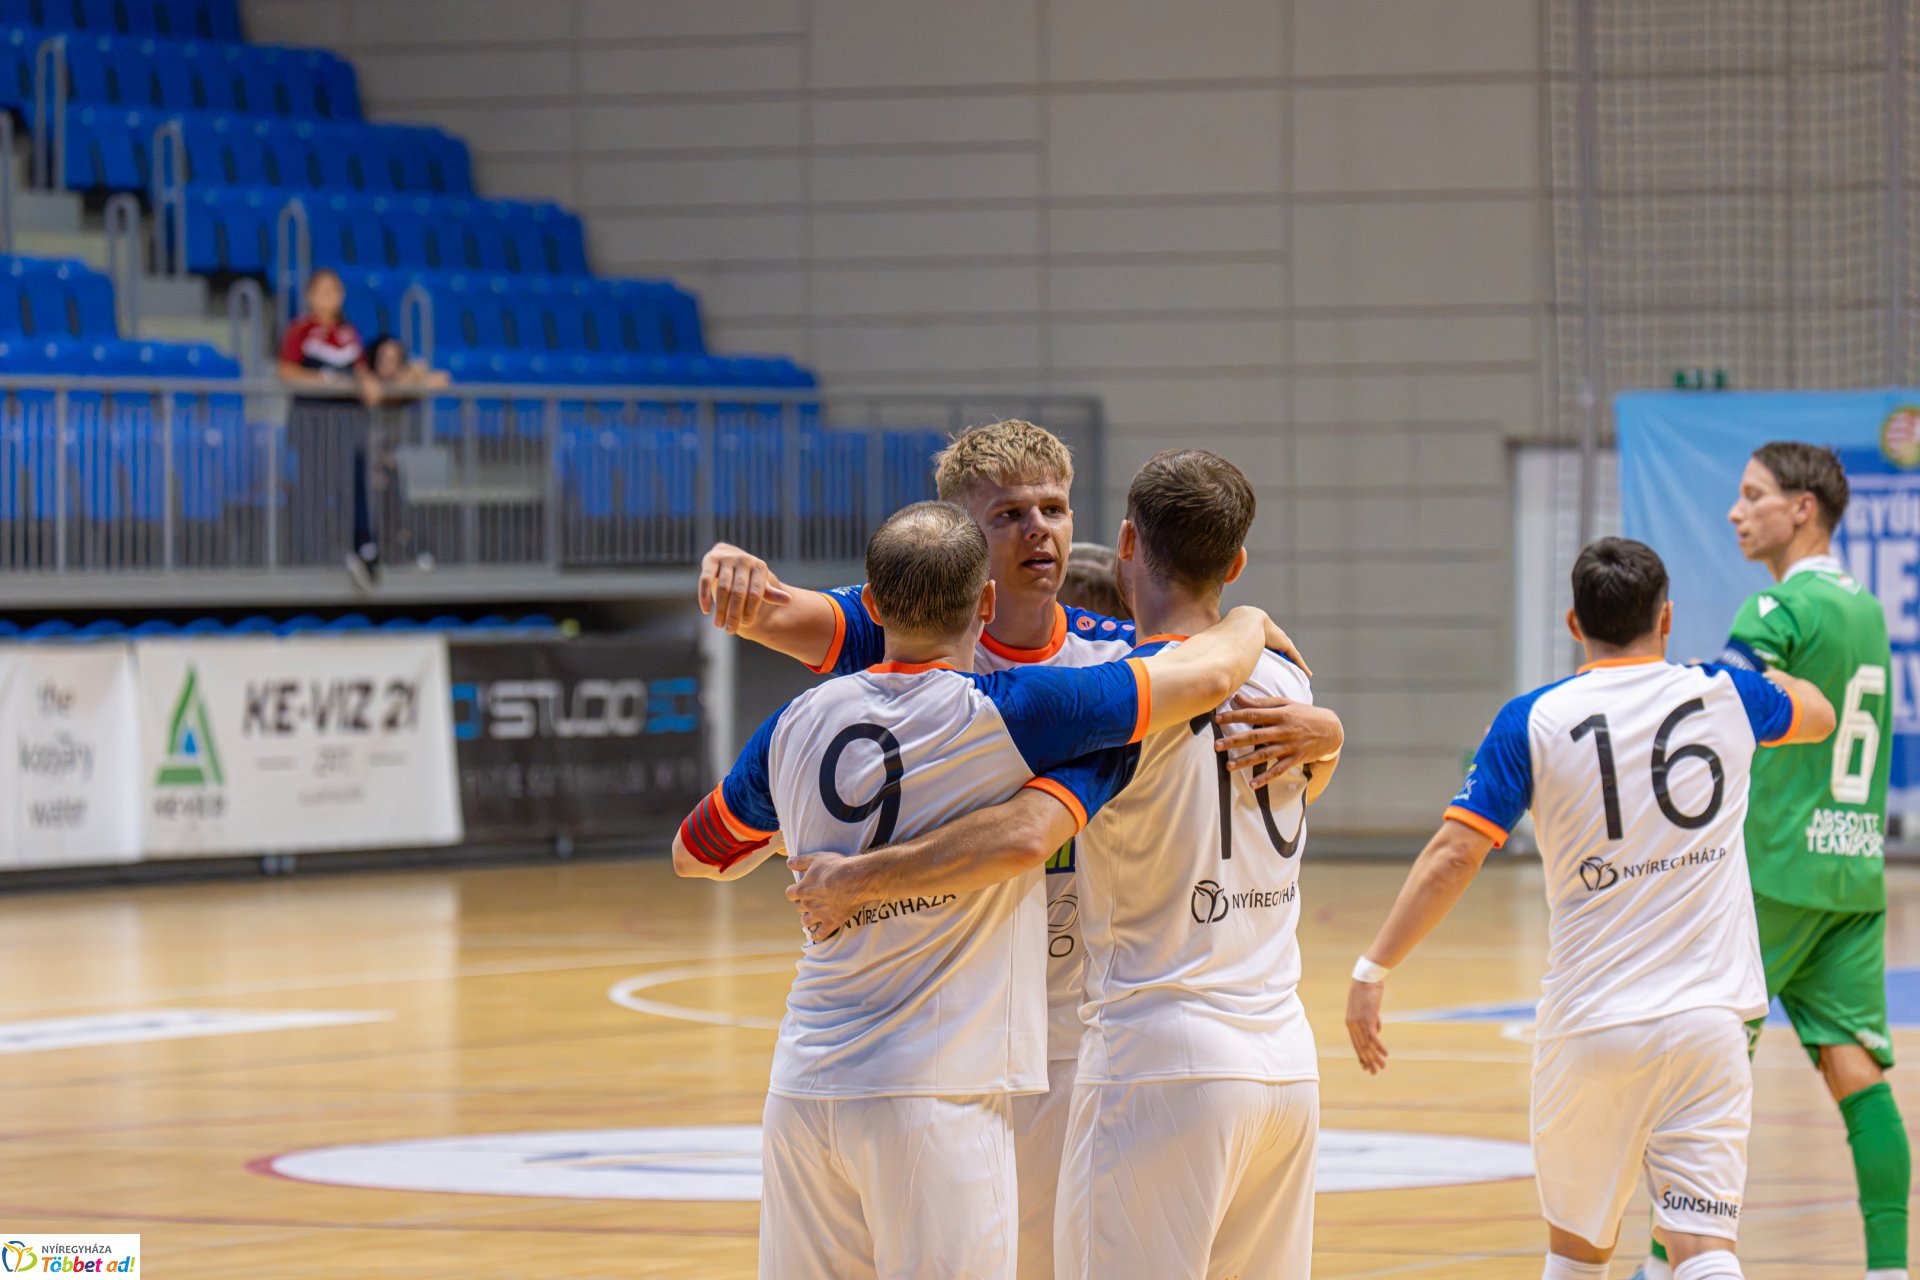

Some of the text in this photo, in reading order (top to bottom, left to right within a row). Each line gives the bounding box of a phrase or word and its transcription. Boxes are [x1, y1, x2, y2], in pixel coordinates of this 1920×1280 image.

[819, 723, 904, 850] 9
[1570, 697, 1725, 840] 16
[1830, 663, 1886, 804] 6
[1662, 1190, 1738, 1219] SUNSHINE
